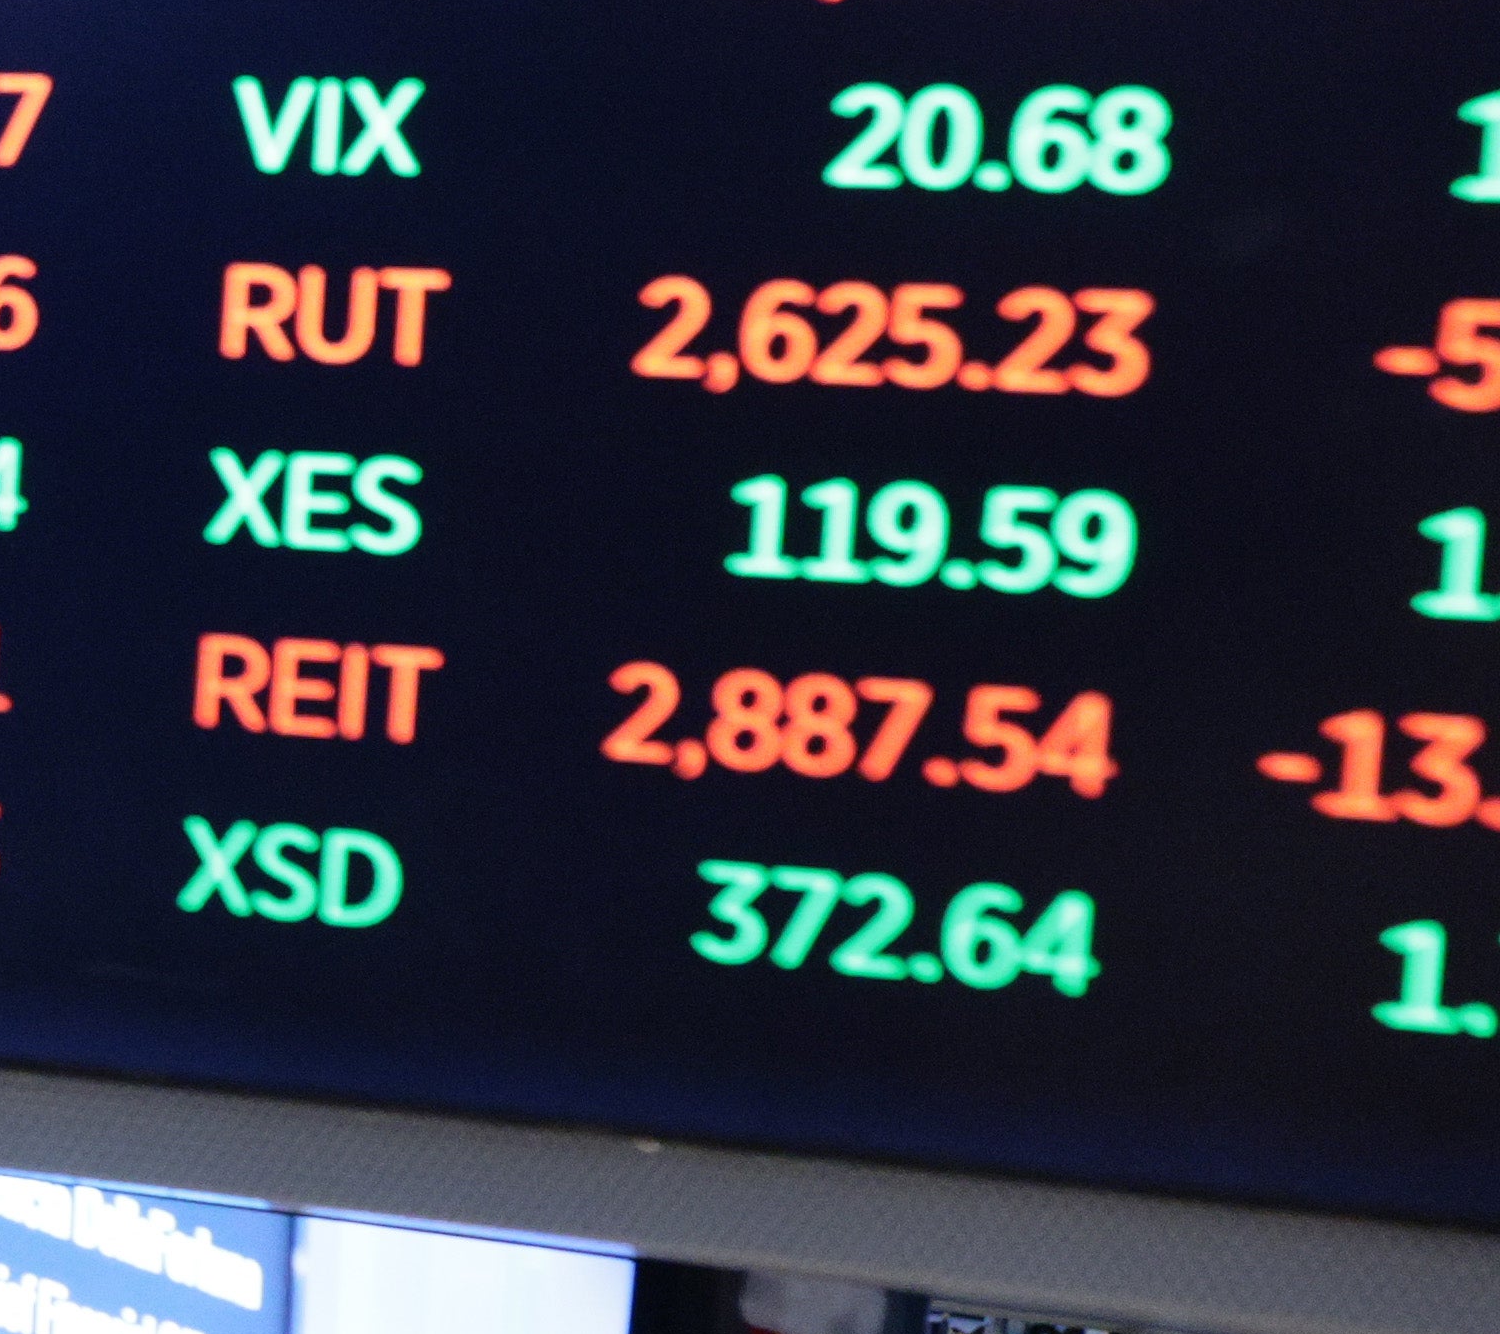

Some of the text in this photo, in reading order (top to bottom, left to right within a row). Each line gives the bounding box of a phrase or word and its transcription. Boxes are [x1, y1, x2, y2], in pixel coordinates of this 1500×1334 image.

[233, 76, 424, 177] VIX
[823, 83, 1171, 195] 20.68
[220, 263, 1500, 411] RUT 2,625.23 -5
[204, 448, 422, 555] XES
[725, 475, 1137, 597] 119.59
[194, 634, 444, 743] REIT
[603, 662, 1116, 797] 2,887.54
[179, 817, 402, 927] XSD
[692, 861, 1098, 995] 372.64
